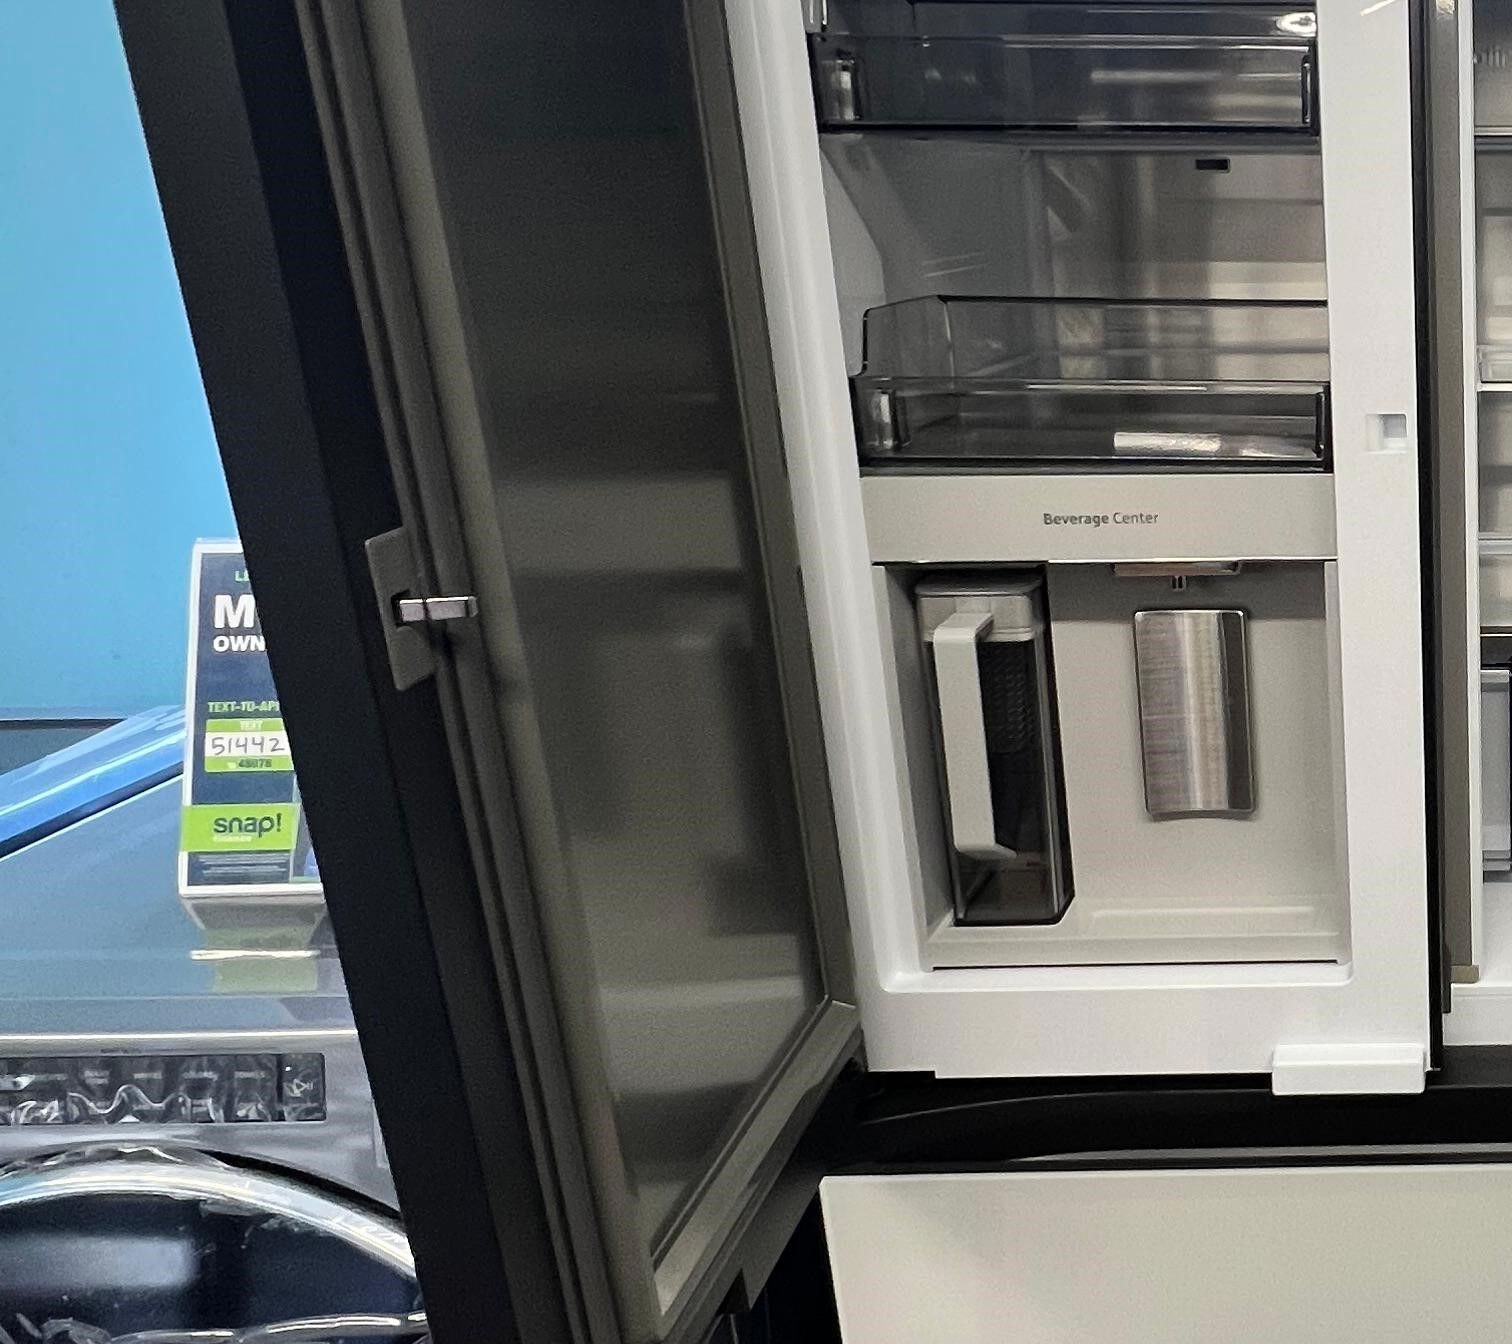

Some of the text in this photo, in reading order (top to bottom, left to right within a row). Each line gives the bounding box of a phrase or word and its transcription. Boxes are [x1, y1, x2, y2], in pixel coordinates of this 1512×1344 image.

[1042, 511, 1160, 528] Beverage Center
[211, 736, 285, 756] 51442
[213, 812, 282, 837] snap!
